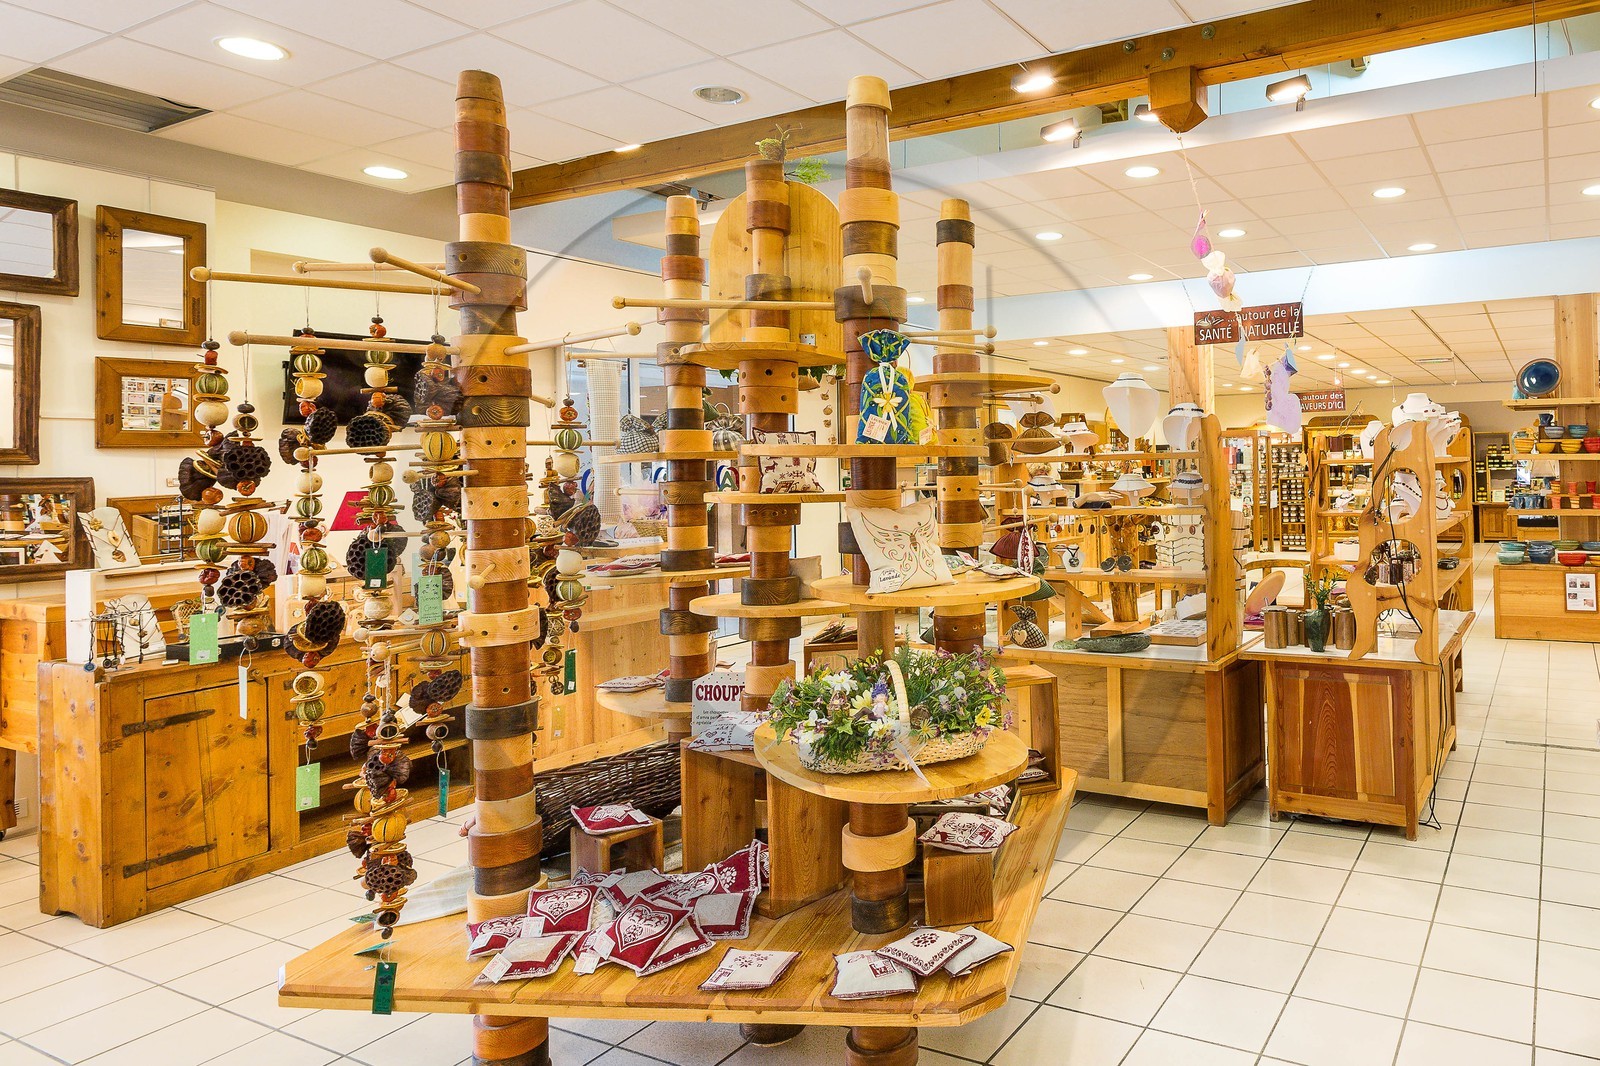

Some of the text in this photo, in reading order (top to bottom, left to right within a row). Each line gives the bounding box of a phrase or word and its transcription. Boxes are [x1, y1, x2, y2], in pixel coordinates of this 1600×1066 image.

[1273, 308, 1286, 318] de
[1290, 306, 1300, 317] la
[1199, 321, 1300, 341] SANTÉ NATURELLE
[1330, 392, 1344, 400] des
[1301, 401, 1344, 411] AVEURS D'ICI
